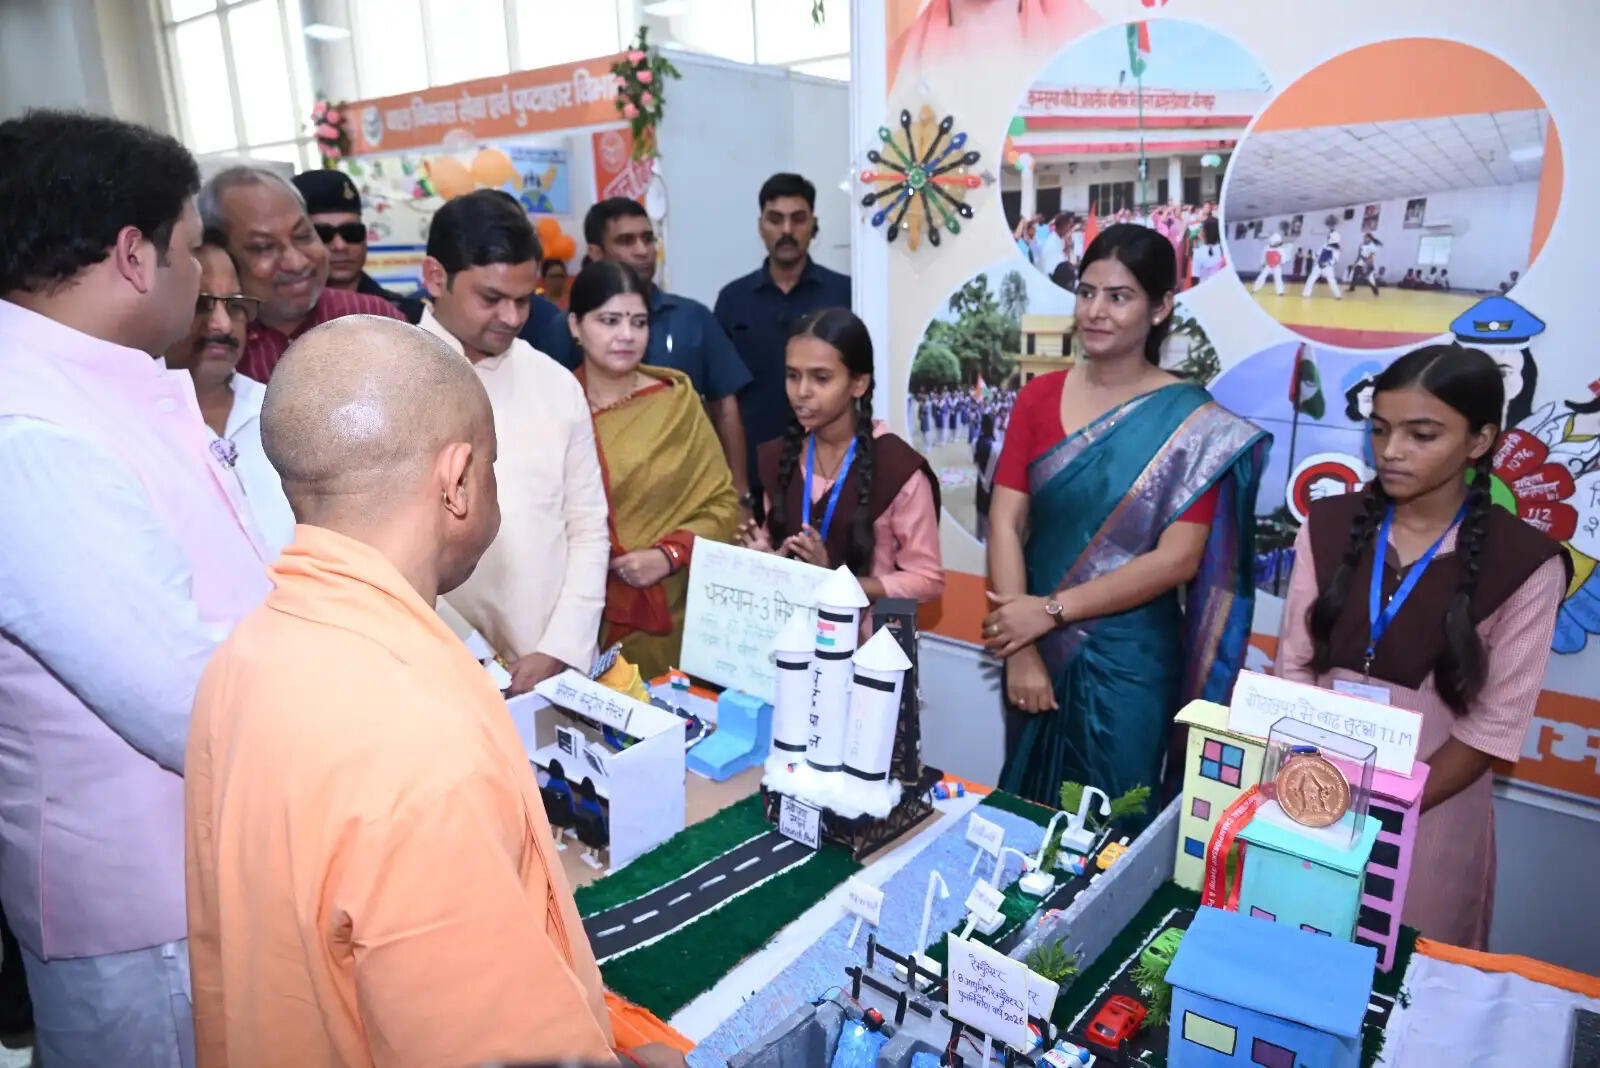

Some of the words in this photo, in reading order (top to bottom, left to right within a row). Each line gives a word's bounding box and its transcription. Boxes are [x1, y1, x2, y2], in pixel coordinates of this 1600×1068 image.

[513, 81, 573, 127] पुष्टाहार
[1528, 508, 1552, 521] 112
[1004, 1012, 1025, 1026] 2026
